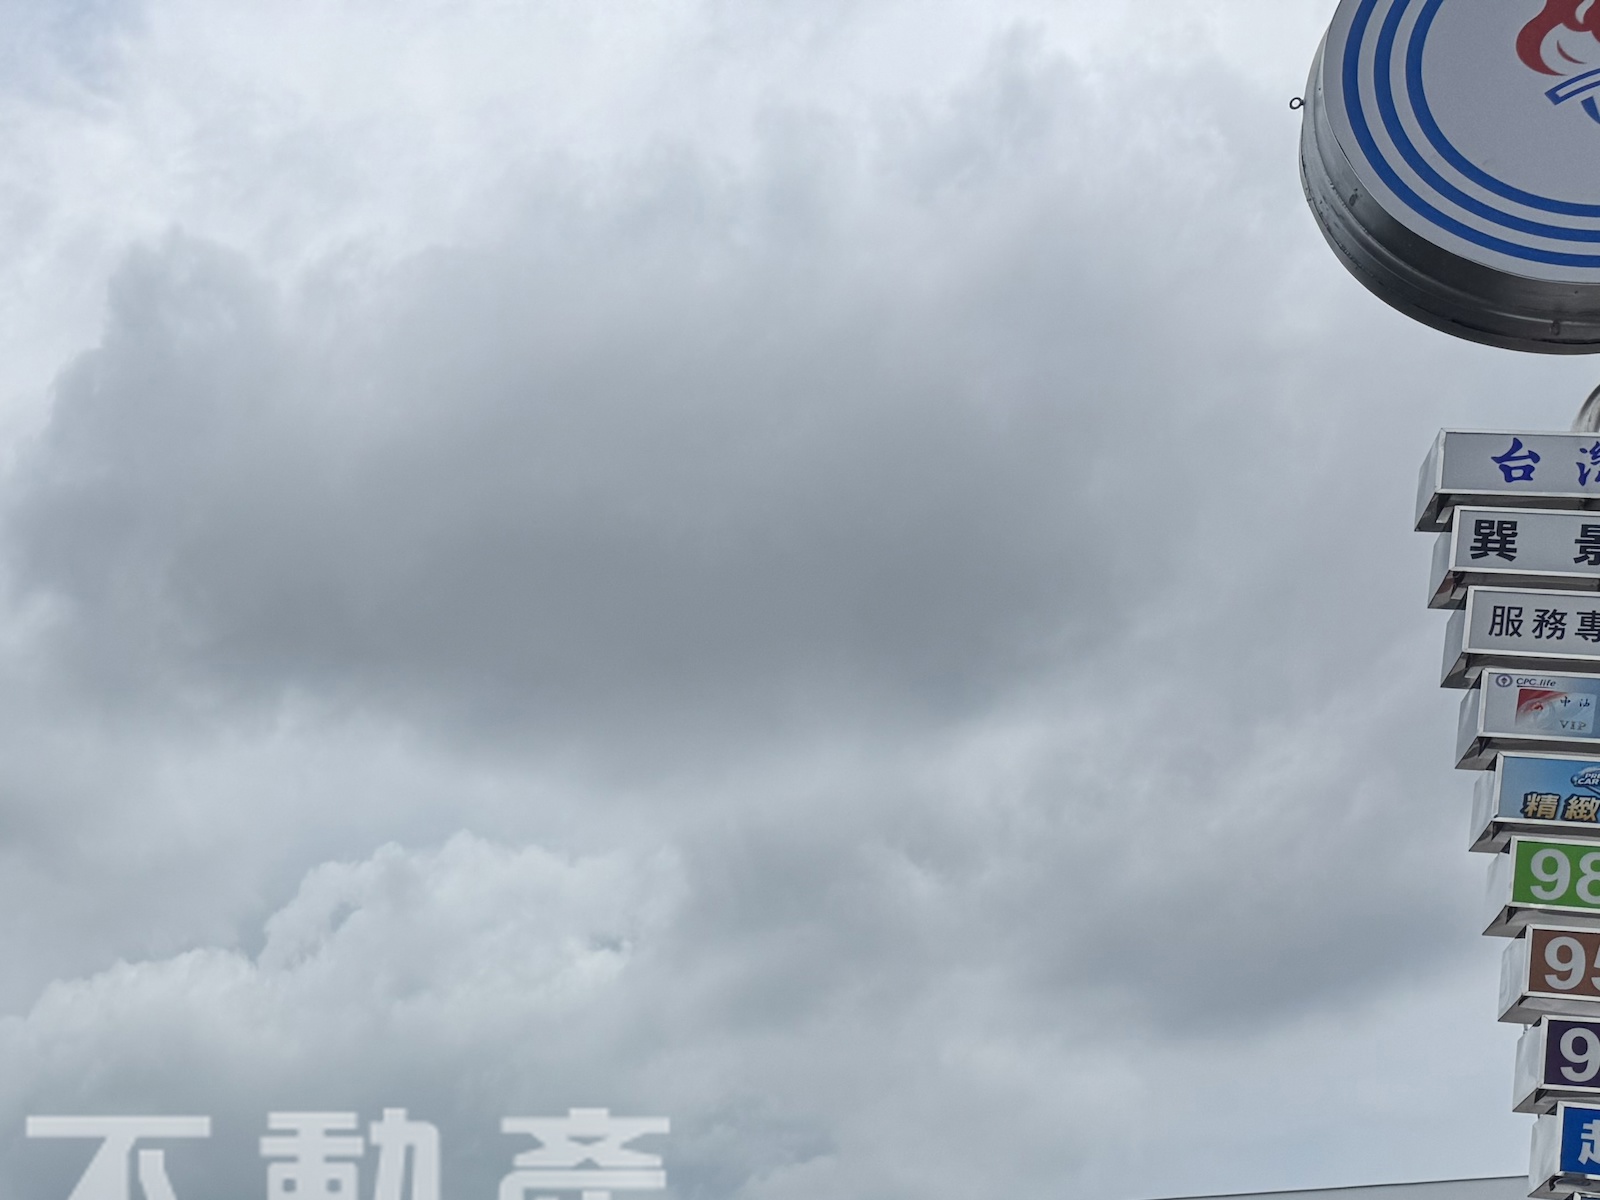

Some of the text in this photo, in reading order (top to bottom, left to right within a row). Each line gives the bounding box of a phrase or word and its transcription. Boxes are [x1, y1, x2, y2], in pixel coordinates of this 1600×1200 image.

[1488, 605, 1600, 643] 服務專
[1560, 720, 1587, 730] VIP
[1523, 792, 1600, 821] 精緻
[1530, 848, 1600, 904] 98
[1544, 936, 1600, 992] 9
